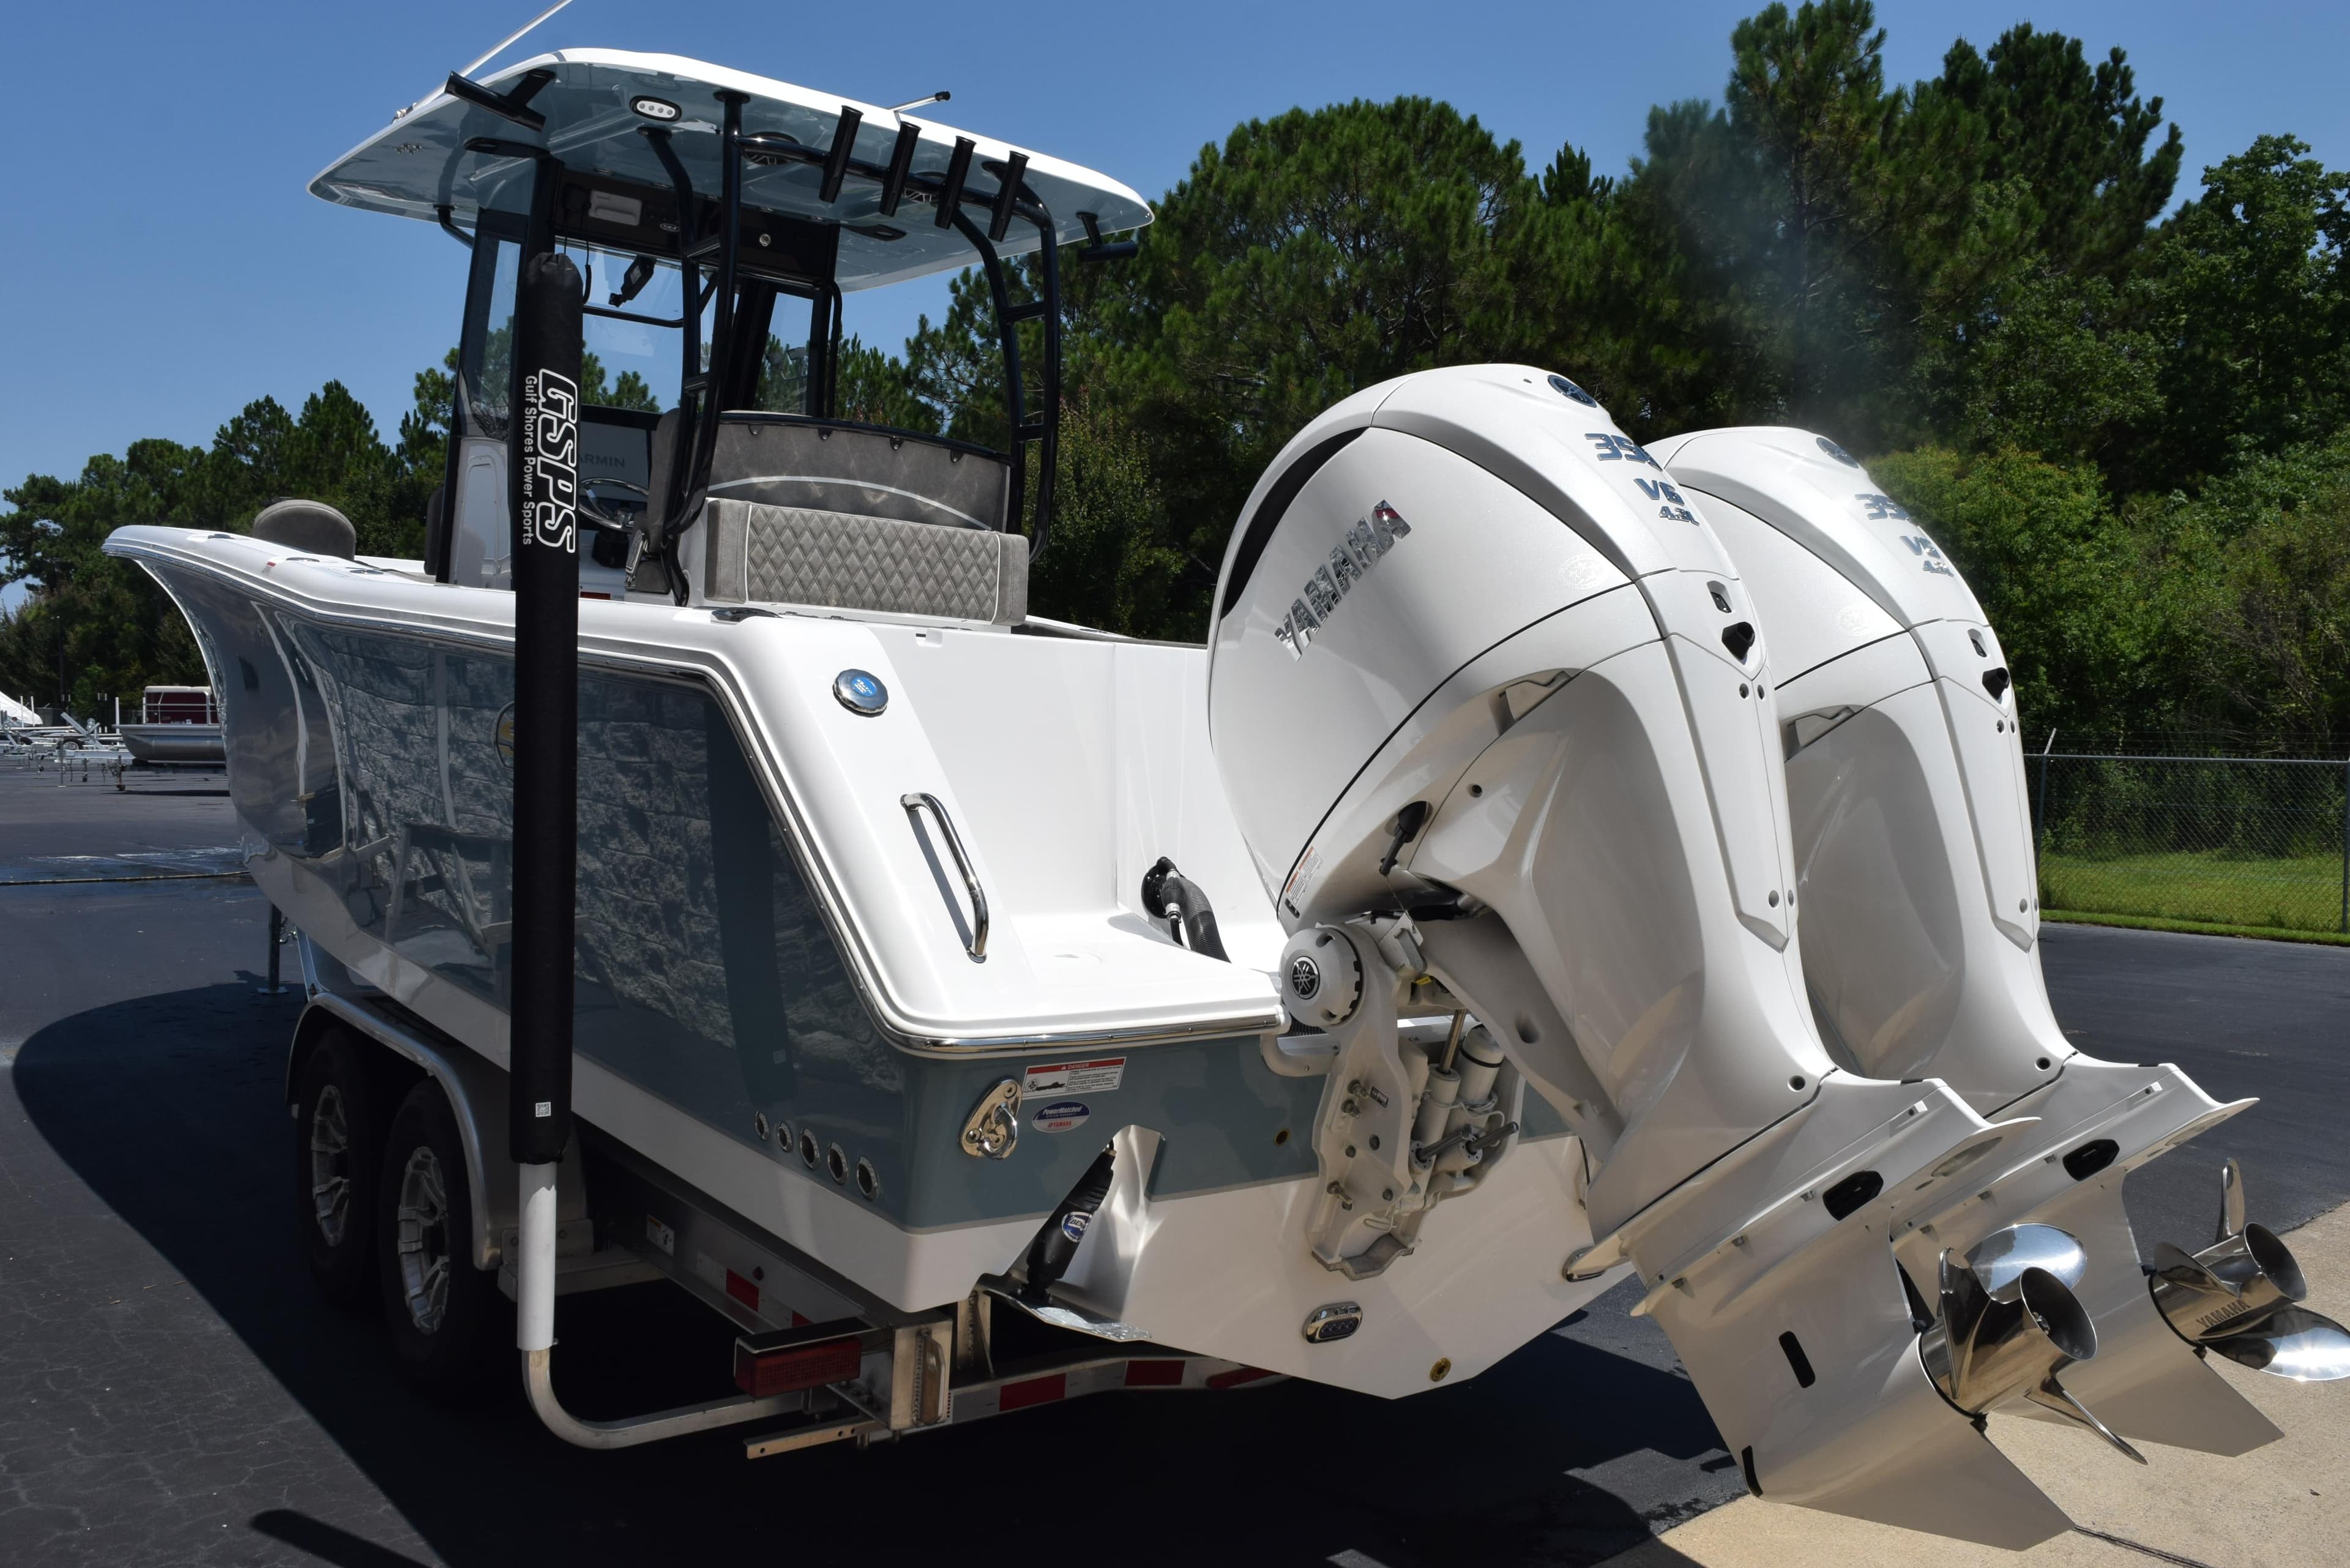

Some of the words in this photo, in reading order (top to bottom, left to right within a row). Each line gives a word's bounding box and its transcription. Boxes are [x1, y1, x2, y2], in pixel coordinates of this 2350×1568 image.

[525, 375, 537, 403] Gulf
[524, 407, 537, 452] Shores
[536, 368, 577, 553] GSPS
[1584, 433, 1663, 472] 35
[524, 457, 536, 498] Power
[1633, 478, 1685, 506] V6
[523, 501, 535, 545] Sports
[1900, 536, 1941, 559] V6
[1274, 499, 1412, 662] YAMAHA
[1043, 1106, 1083, 1114] PowerMatched
[2196, 1299, 2251, 1327] YAMAHA
